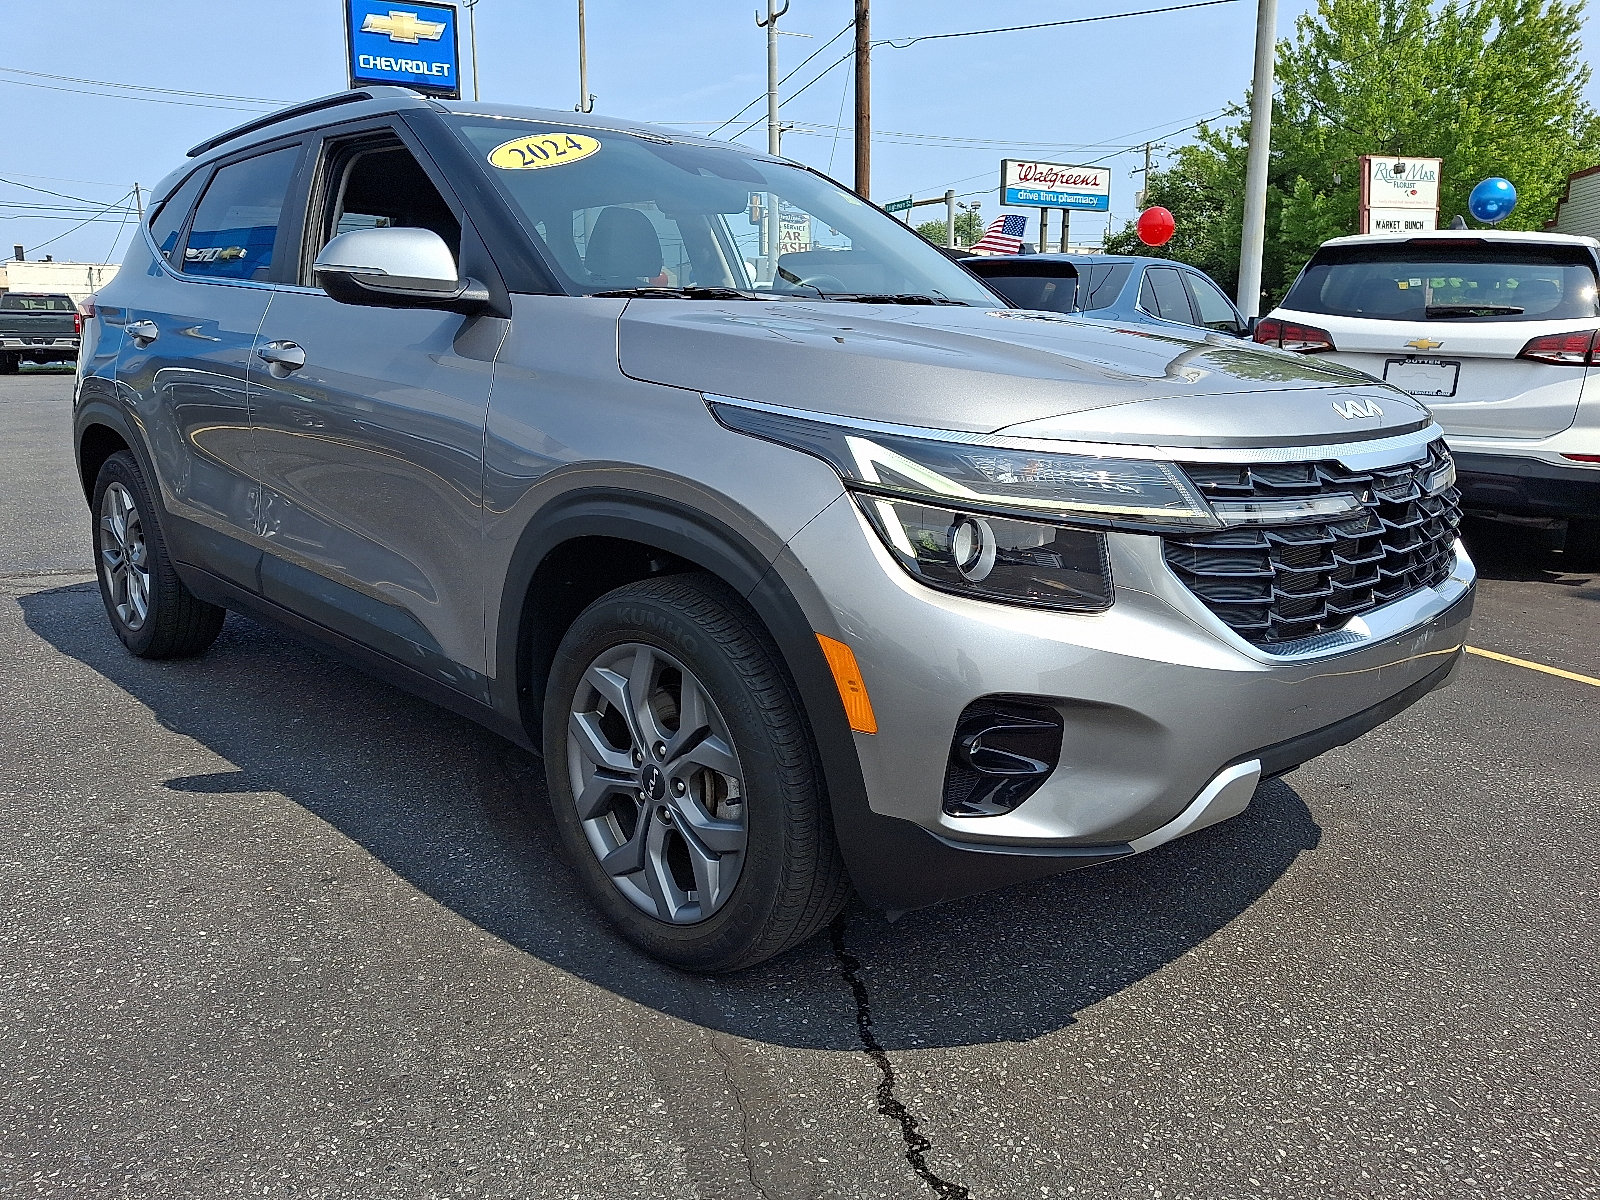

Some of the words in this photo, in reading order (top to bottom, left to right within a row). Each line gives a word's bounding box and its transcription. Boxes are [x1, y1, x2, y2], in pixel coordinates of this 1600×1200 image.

[359, 54, 450, 76] CHEVROLET
[508, 135, 583, 166] 2024
[1017, 163, 1100, 189] Walgreens
[1018, 190, 1038, 200] drive
[1041, 191, 1057, 202] thru
[1058, 195, 1098, 206] pharmacy
[783, 223, 806, 231] SERVICE
[1376, 221, 1400, 229] MARKET
[1405, 221, 1424, 230] BUNCH
[780, 231, 801, 241] AR
[779, 243, 808, 253] ASH
[1331, 399, 1384, 420] KIA
